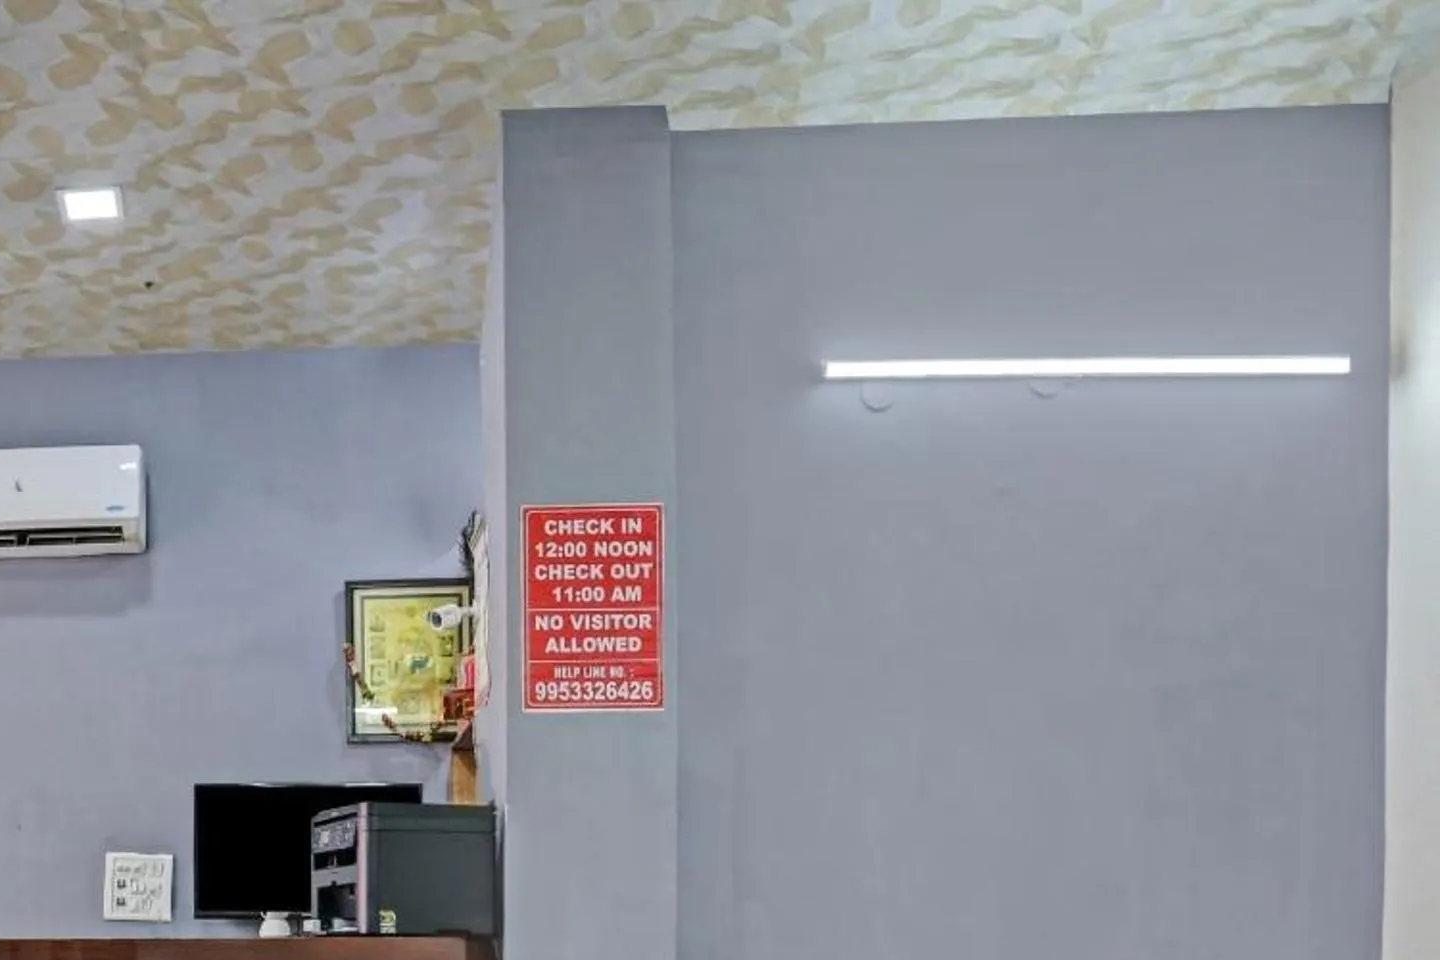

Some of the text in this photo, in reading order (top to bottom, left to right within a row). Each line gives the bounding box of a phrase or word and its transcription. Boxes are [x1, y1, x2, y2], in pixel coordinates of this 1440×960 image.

[544, 517, 642, 535] CHECK IN
[535, 541, 653, 558] 12:00 NOON
[534, 563, 653, 580] CHECK OUT
[552, 586, 642, 603] 11:00 AM
[534, 613, 653, 631] NO VISITOR
[544, 636, 643, 654] ALLOWED
[554, 666, 581, 679] HELP
[583, 665, 607, 678] LINE
[535, 681, 653, 700] 9953326426
